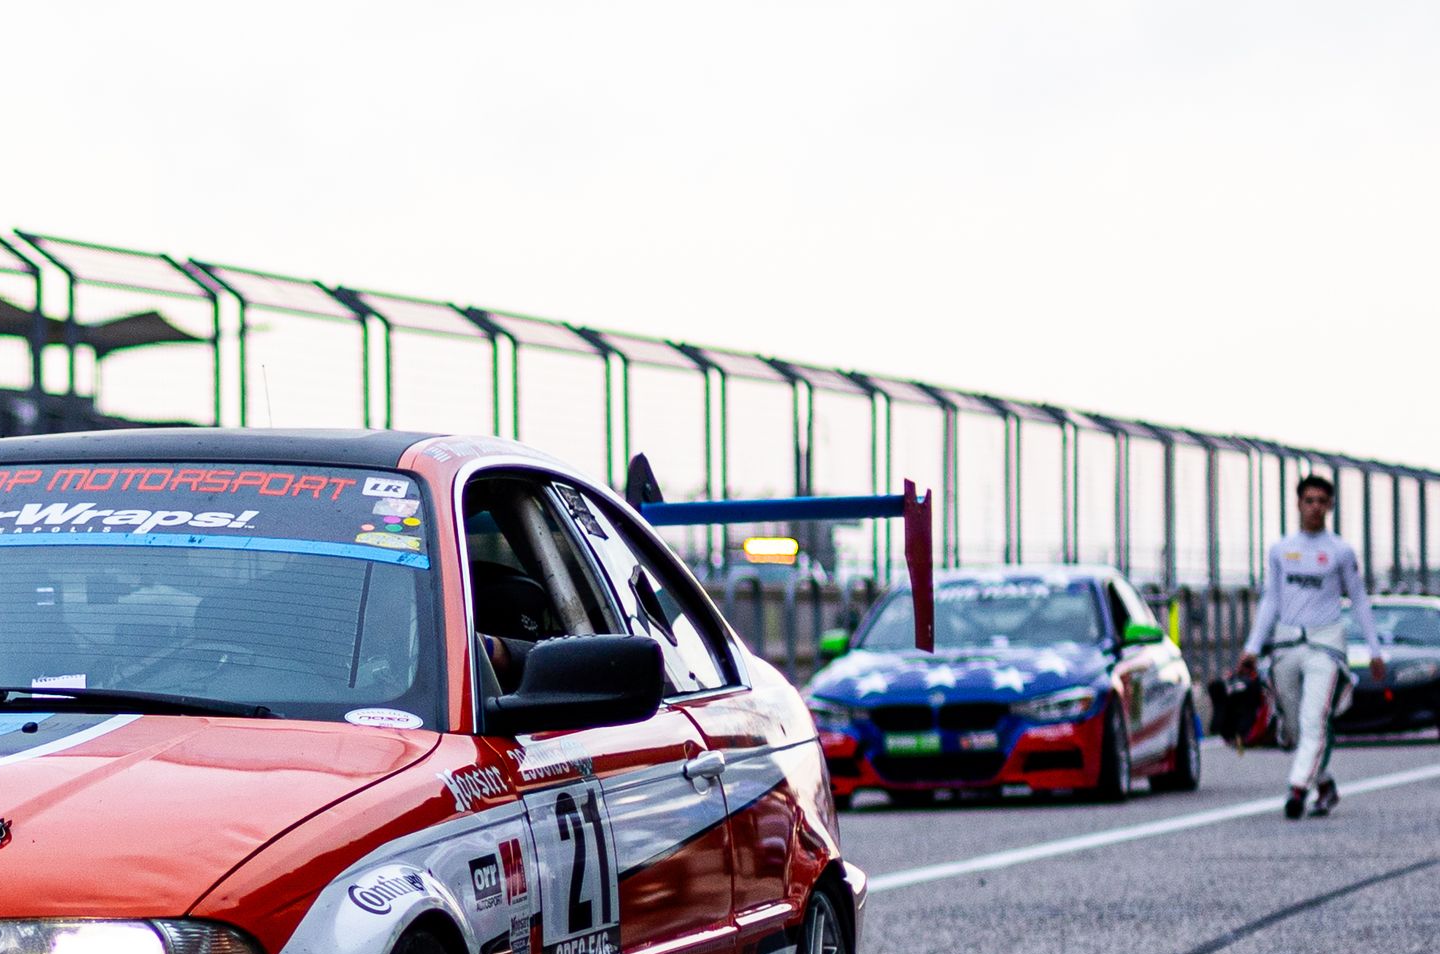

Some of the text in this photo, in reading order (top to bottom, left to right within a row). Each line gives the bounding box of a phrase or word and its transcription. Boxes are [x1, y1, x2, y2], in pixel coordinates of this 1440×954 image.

[45, 468, 357, 501] MOTORSPORT
[473, 863, 499, 892] orr
[554, 790, 613, 934] 21
